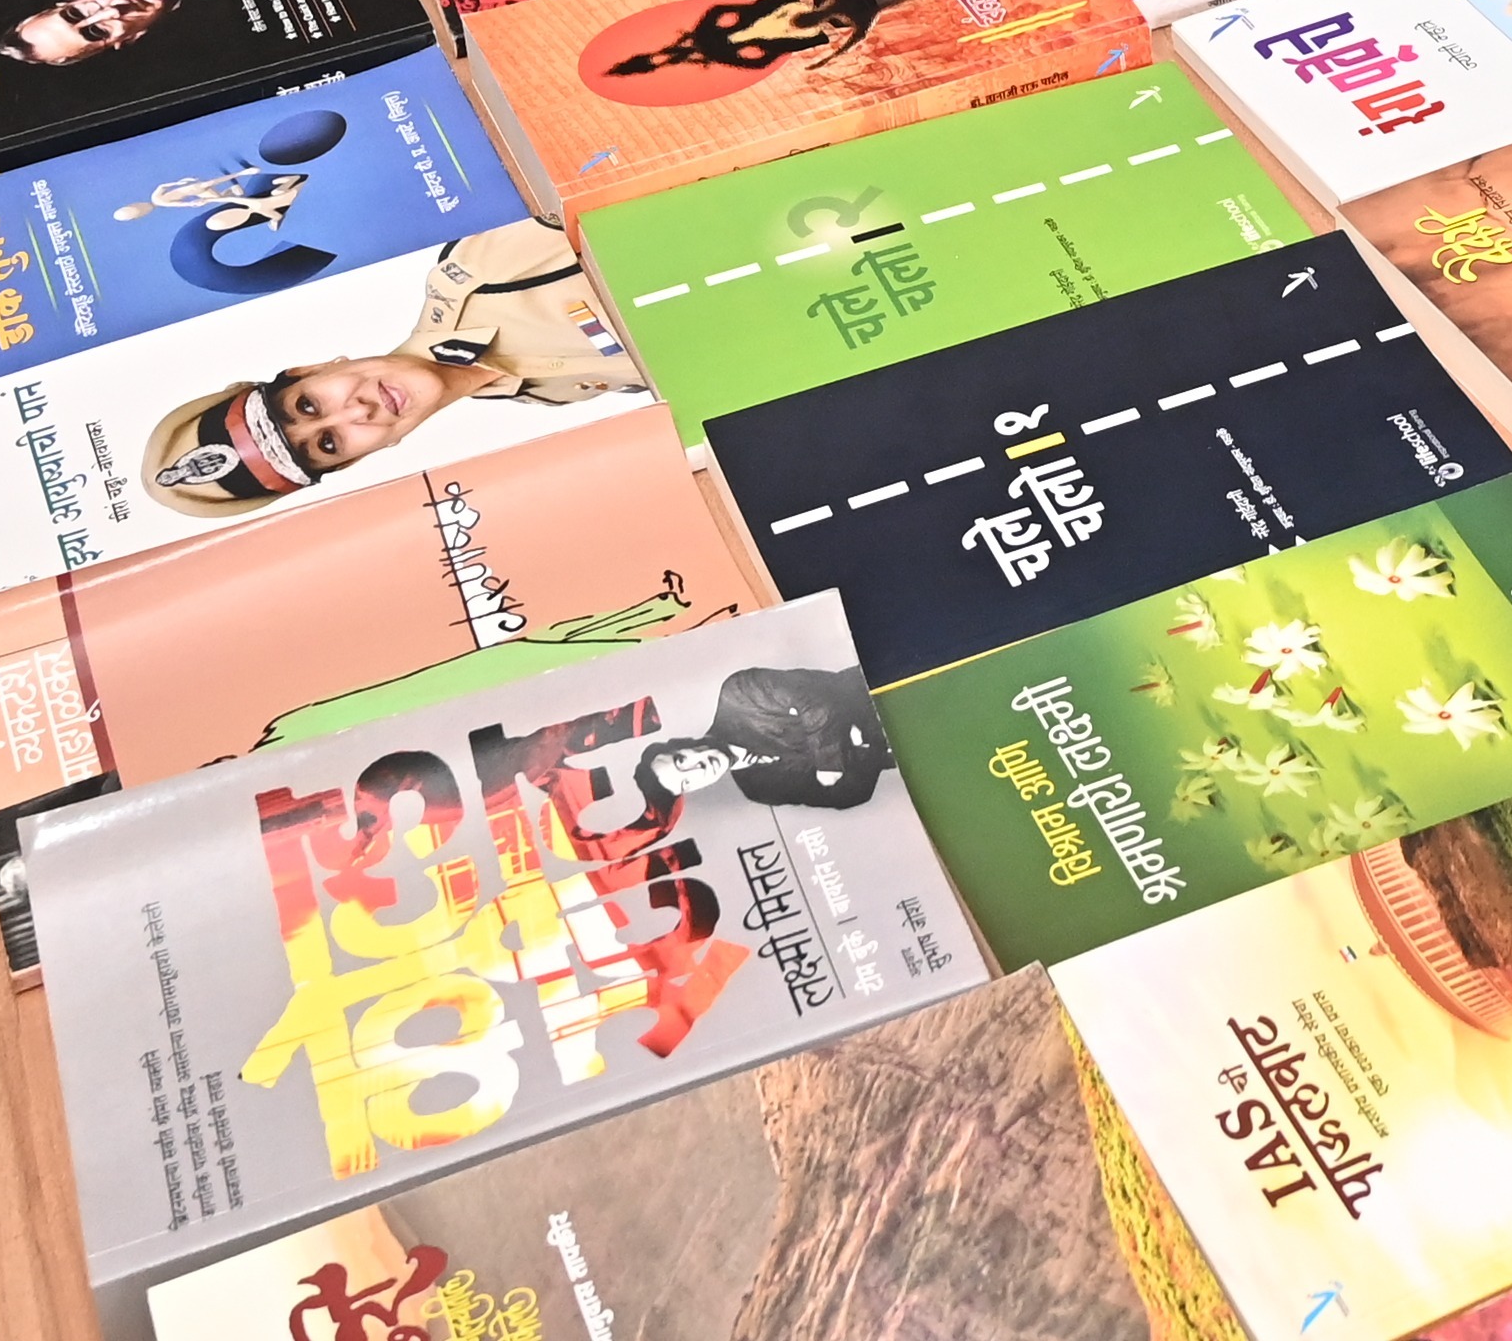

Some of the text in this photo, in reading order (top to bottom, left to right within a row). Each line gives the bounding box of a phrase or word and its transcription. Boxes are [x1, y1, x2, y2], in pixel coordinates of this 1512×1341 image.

[1255, 13, 1444, 136] रंग पूर्वेचे
[1437, 43, 1478, 71] ज्योती
[796, 186, 935, 349] चले चलो २
[1218, 198, 1261, 243] lifeschool
[0, 381, 86, 524] आयुष्याची पानं
[1387, 413, 1438, 467] lifeschool
[962, 403, 1103, 586] चले चलो १
[993, 740, 1101, 885] विश्राम आणि
[1013, 677, 1184, 904] श्रमणारी लक्ष्मी
[141, 901, 165, 947] केलेली
[737, 841, 833, 1016] लक्ष्मी मित्तल
[836, 930, 879, 962] बुके
[896, 896, 952, 973] सुभाष जोशी
[854, 961, 884, 996] टीम
[168, 1029, 191, 1083] असलेल्या
[1217, 1099, 1316, 1207] IAS
[1229, 1017, 1381, 1217] पाऊलवाट
